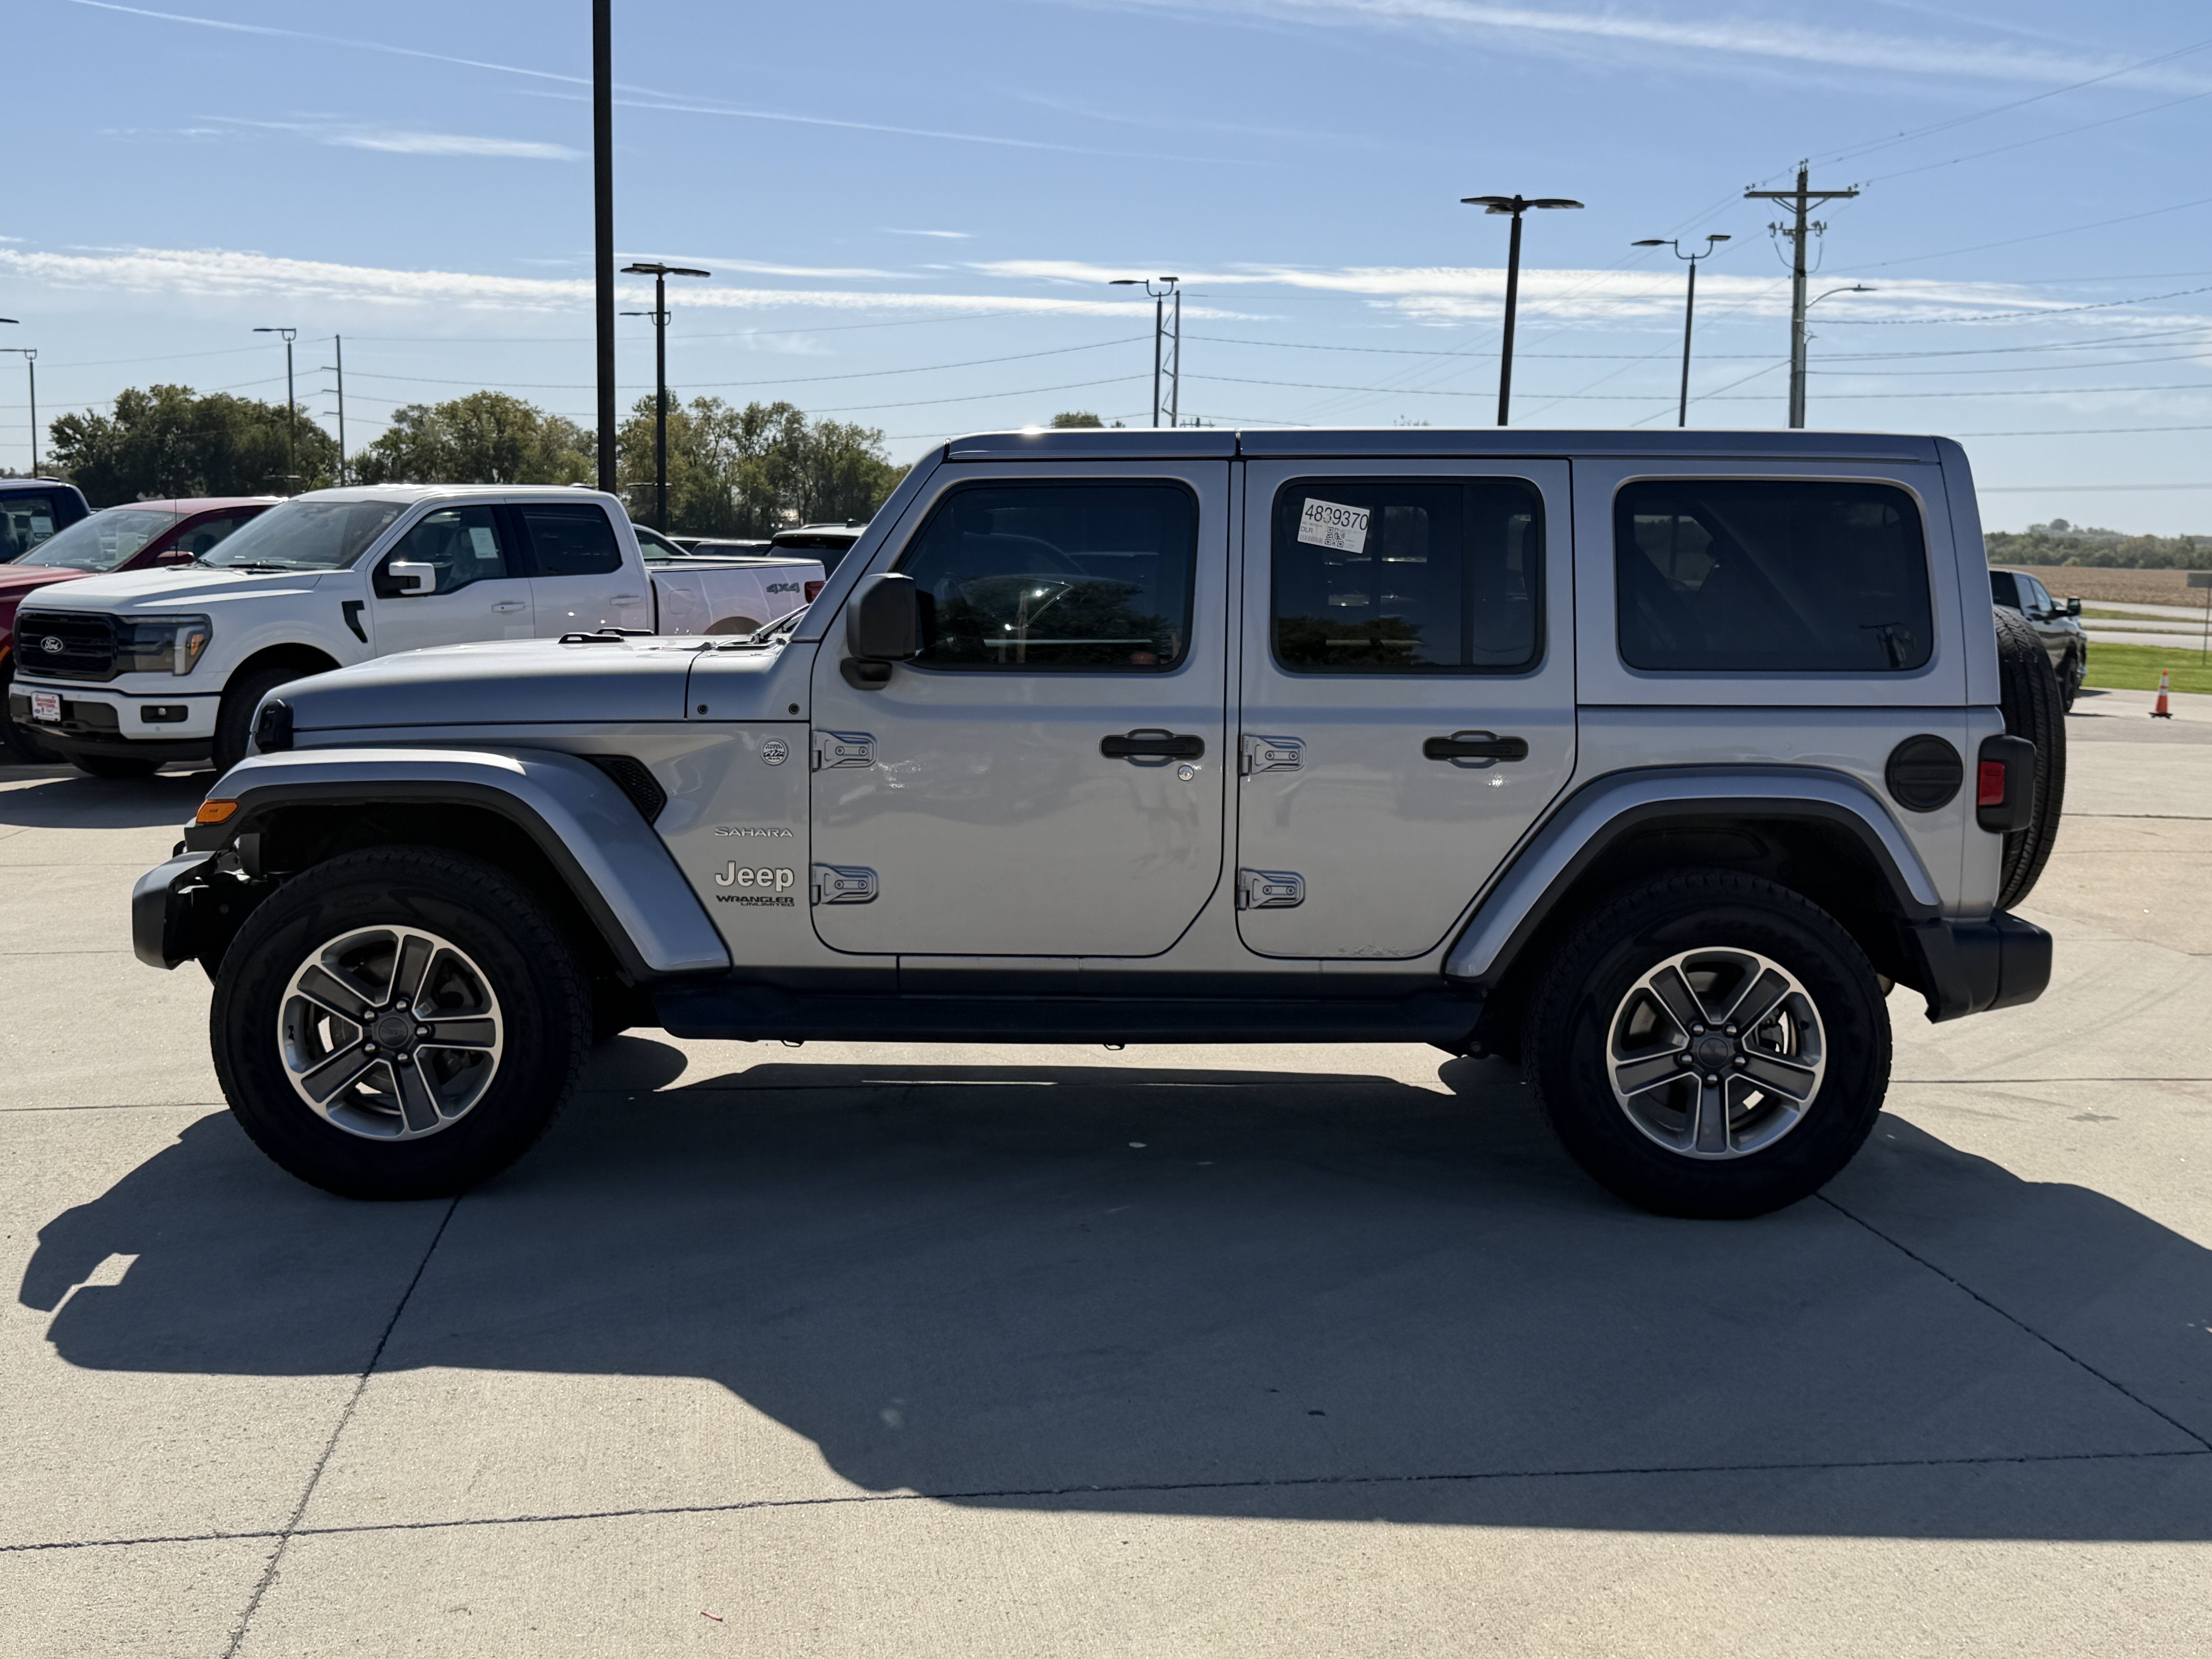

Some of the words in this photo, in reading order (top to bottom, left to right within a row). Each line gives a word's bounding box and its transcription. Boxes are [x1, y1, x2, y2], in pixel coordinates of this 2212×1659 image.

[1305, 505, 1368, 530] 4839370
[715, 826, 794, 837] SAHARA
[715, 860, 794, 892] Jeep
